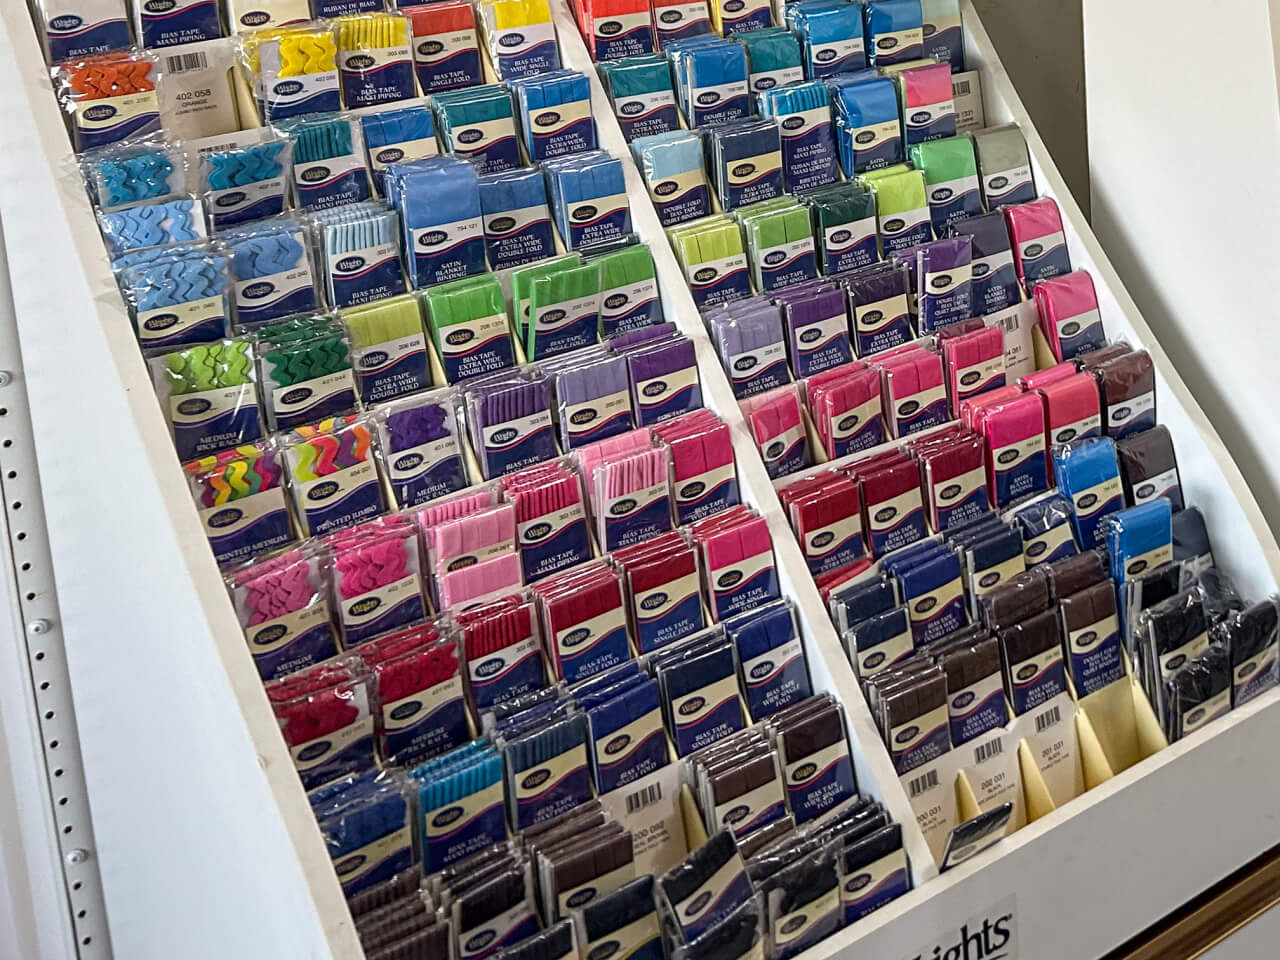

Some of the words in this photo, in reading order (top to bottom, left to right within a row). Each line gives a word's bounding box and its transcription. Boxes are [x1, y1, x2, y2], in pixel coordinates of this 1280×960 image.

[156, 37, 178, 46] MAXI
[179, 33, 206, 42] PIPING
[160, 31, 177, 39] BIAS
[178, 28, 200, 36] TAPE
[69, 48, 88, 56] BIAS
[90, 45, 110, 53] TAPE
[531, 56, 546, 64] TAPE
[453, 75, 471, 83] FOLD
[175, 92, 192, 101] 402
[194, 89, 211, 97] 058
[563, 133, 578, 141] TAPE
[569, 143, 587, 151] FOLD
[318, 196, 336, 204] BIAS
[337, 193, 353, 201] TAPE
[519, 234, 534, 242] TAPE
[500, 243, 521, 252] EXTRA
[522, 239, 542, 248] WIDE
[498, 249, 524, 259] DOUBLE
[525, 245, 543, 254] FOLD
[435, 265, 467, 276] BLANKET
[441, 260, 462, 270] SATIN
[436, 271, 467, 282] BINDING
[352, 291, 369, 299] BIAS
[370, 287, 388, 295] TAPE
[458, 361, 480, 371] EXTRA
[481, 355, 502, 365] WIDE
[462, 355, 479, 364] BIAS
[480, 351, 496, 359] TAPE
[458, 368, 484, 378] DOUBLE
[485, 361, 504, 370] FOLD
[372, 383, 394, 393] EXTRA
[396, 376, 419, 387] WIDE
[375, 378, 393, 386] BIAS
[394, 372, 410, 381] TAPE
[370, 390, 398, 401] DOUBLE
[400, 382, 419, 393] FOLD
[416, 483, 447, 496] MEDIUM
[316, 515, 350, 533] PRINTED
[352, 505, 377, 520] JUMBO
